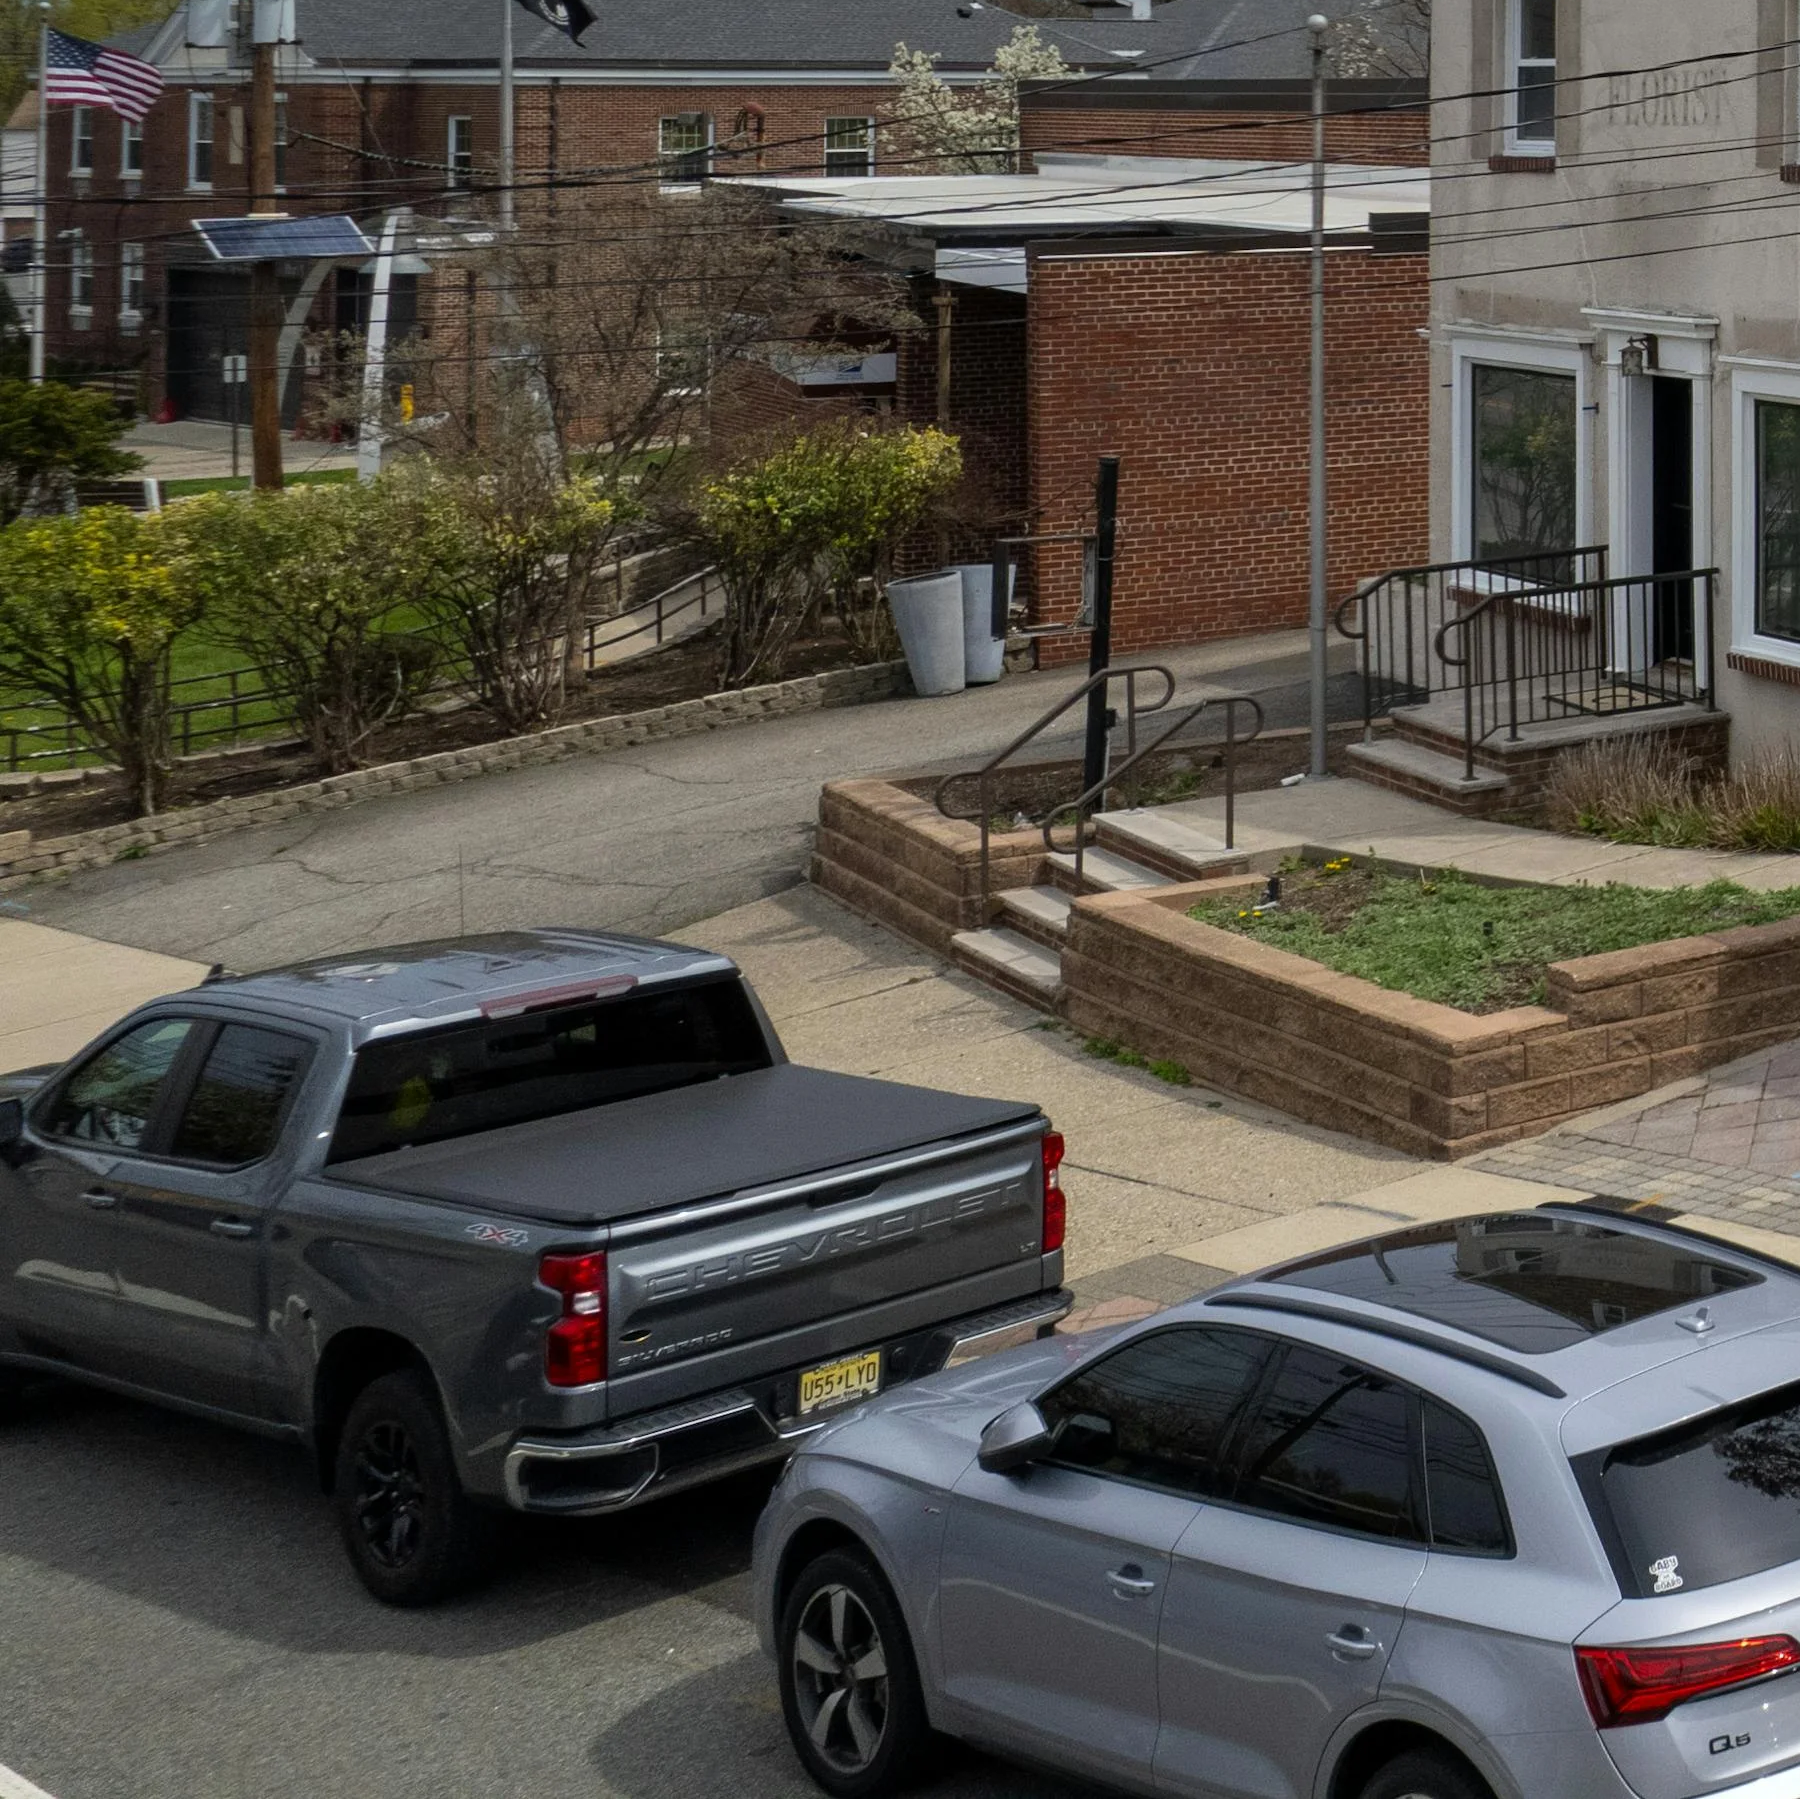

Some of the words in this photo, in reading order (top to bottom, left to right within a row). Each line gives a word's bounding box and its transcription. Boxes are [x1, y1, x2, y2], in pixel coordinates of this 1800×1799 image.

[1606, 67, 1727, 126] FLORIST
[646, 1182, 1022, 1302] CHEVROLET
[616, 1327, 734, 1368] SILVERADO
[1709, 1732, 1751, 1754] Q5
